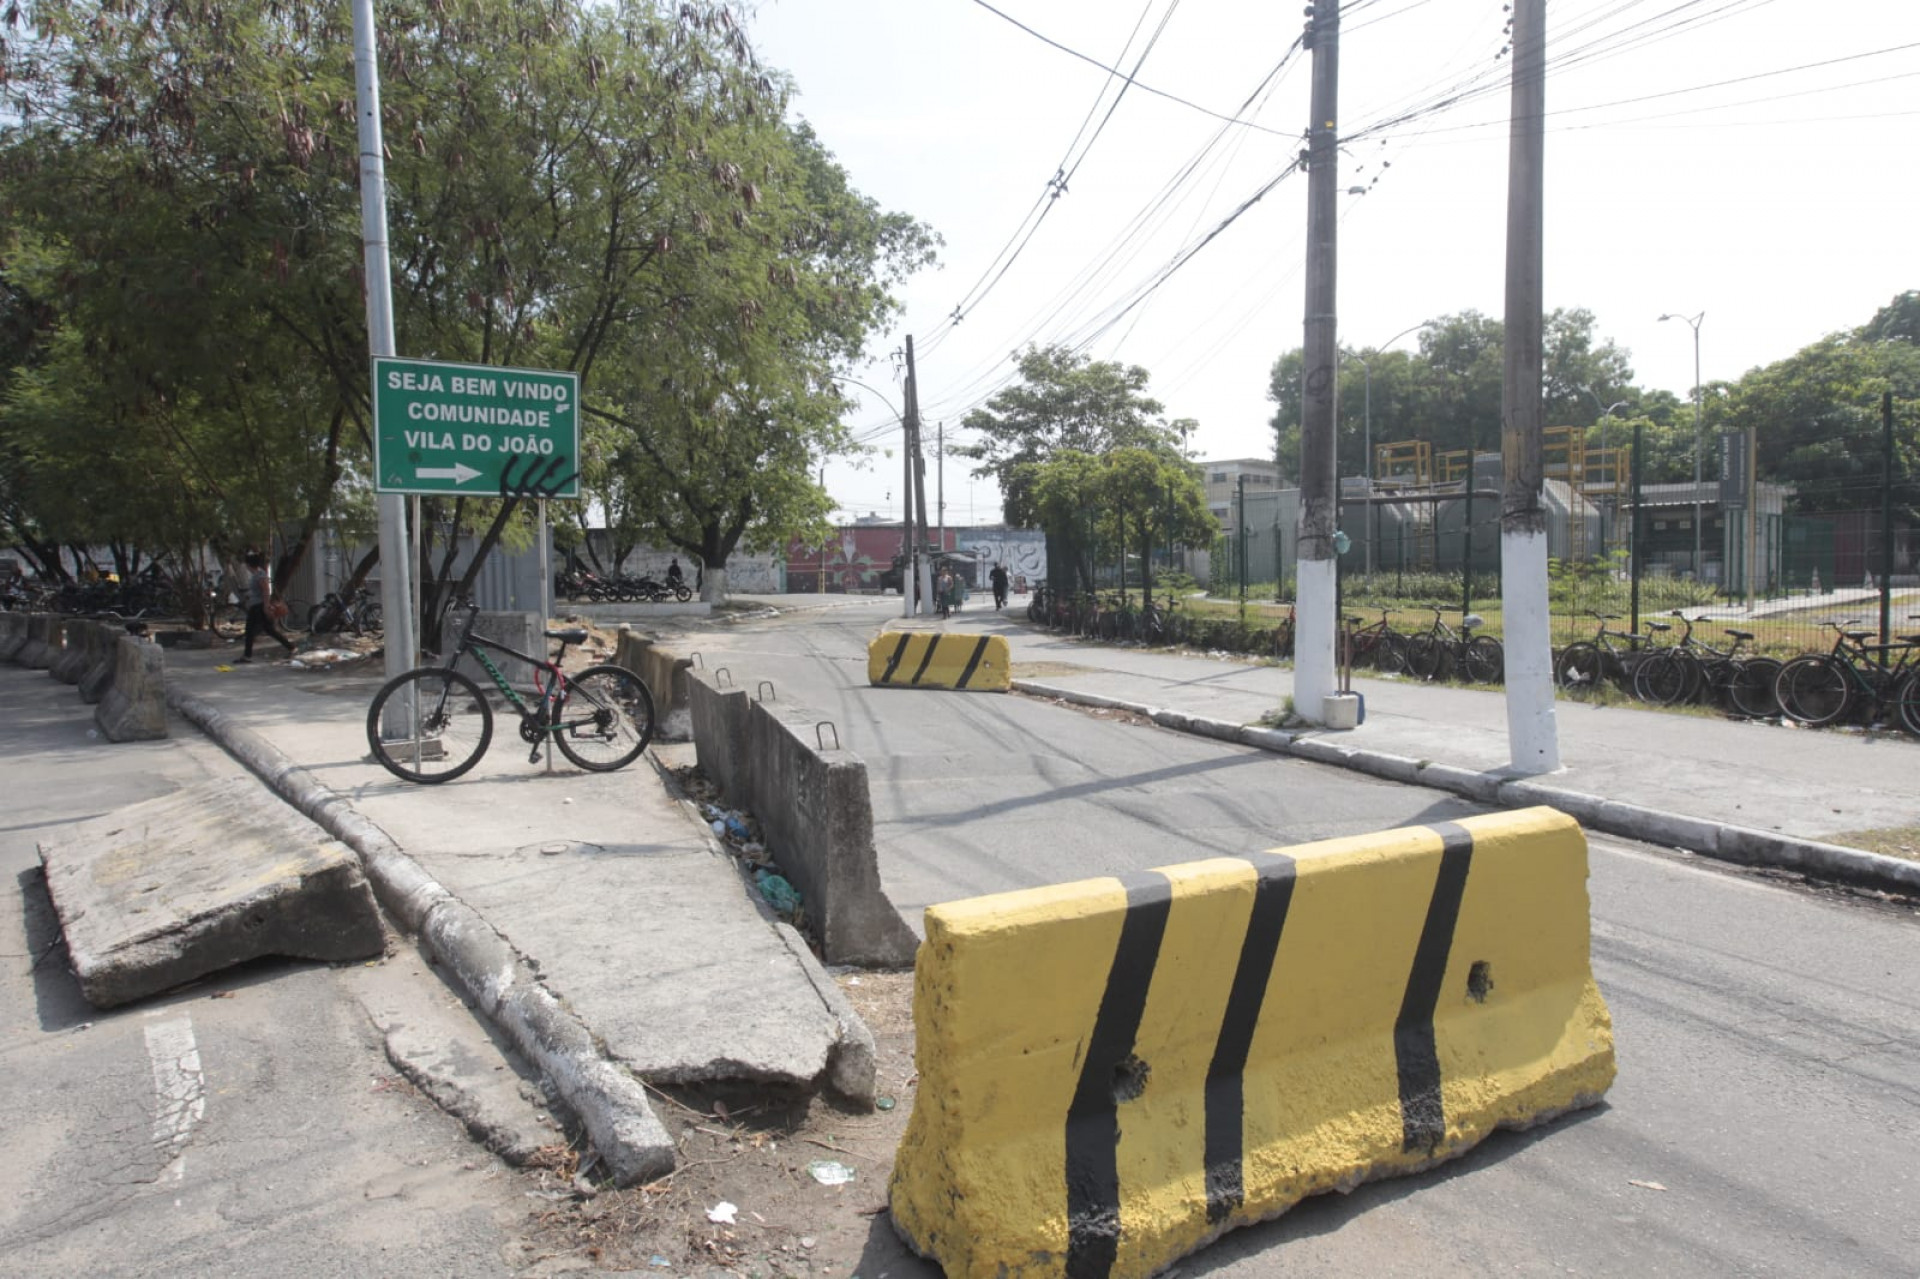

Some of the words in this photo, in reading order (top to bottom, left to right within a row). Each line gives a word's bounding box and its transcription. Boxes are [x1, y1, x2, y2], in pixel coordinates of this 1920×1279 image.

[387, 371, 444, 393] SEJA
[451, 377, 497, 397] BEM
[503, 380, 567, 402] VINDO
[407, 402, 550, 428] COMUNIDADE
[404, 430, 456, 450] VILA
[462, 434, 492, 451] DO
[498, 434, 554, 455] JOÃO
